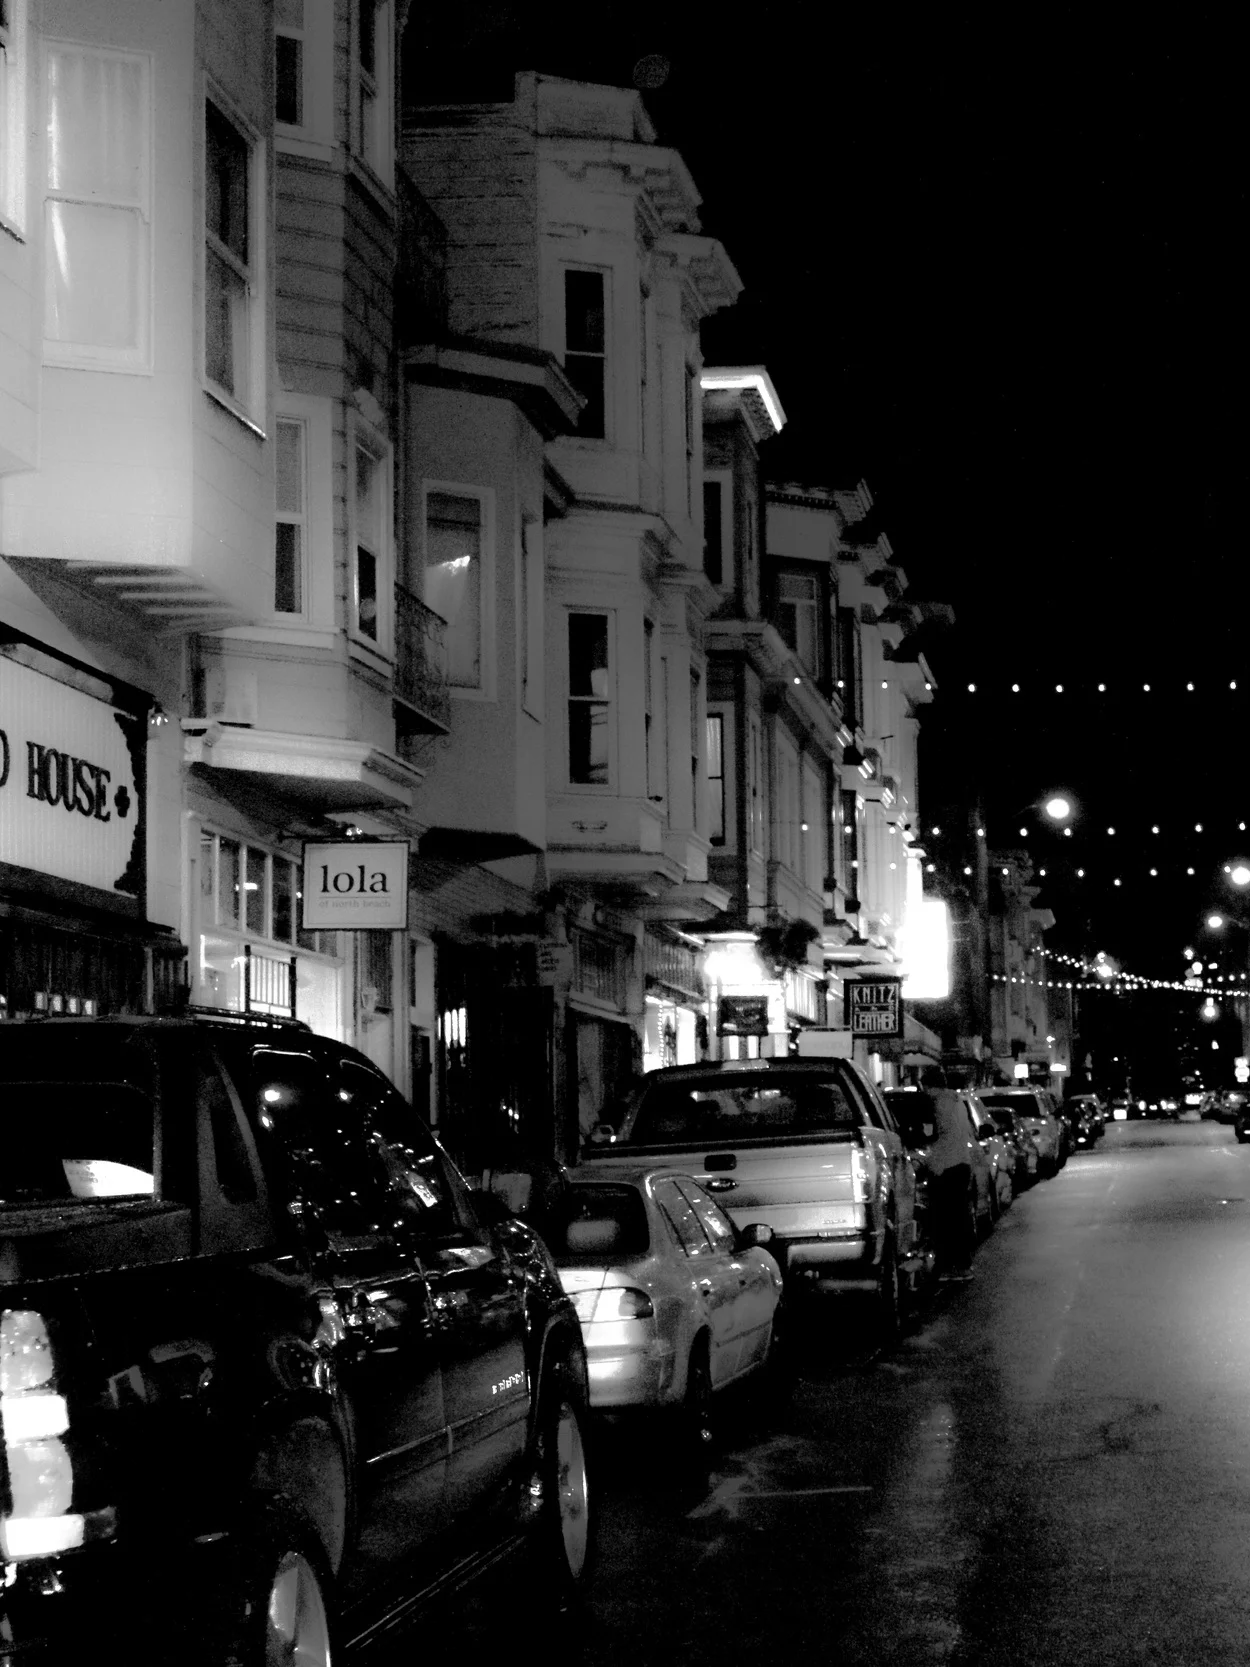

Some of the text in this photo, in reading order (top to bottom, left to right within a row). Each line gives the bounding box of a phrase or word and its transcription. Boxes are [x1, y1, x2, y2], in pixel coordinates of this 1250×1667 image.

[26, 741, 111, 822] HOUSE
[320, 865, 390, 893] lola
[853, 986, 895, 1004] KNITZ
[853, 1013, 895, 1031] LEATHER
